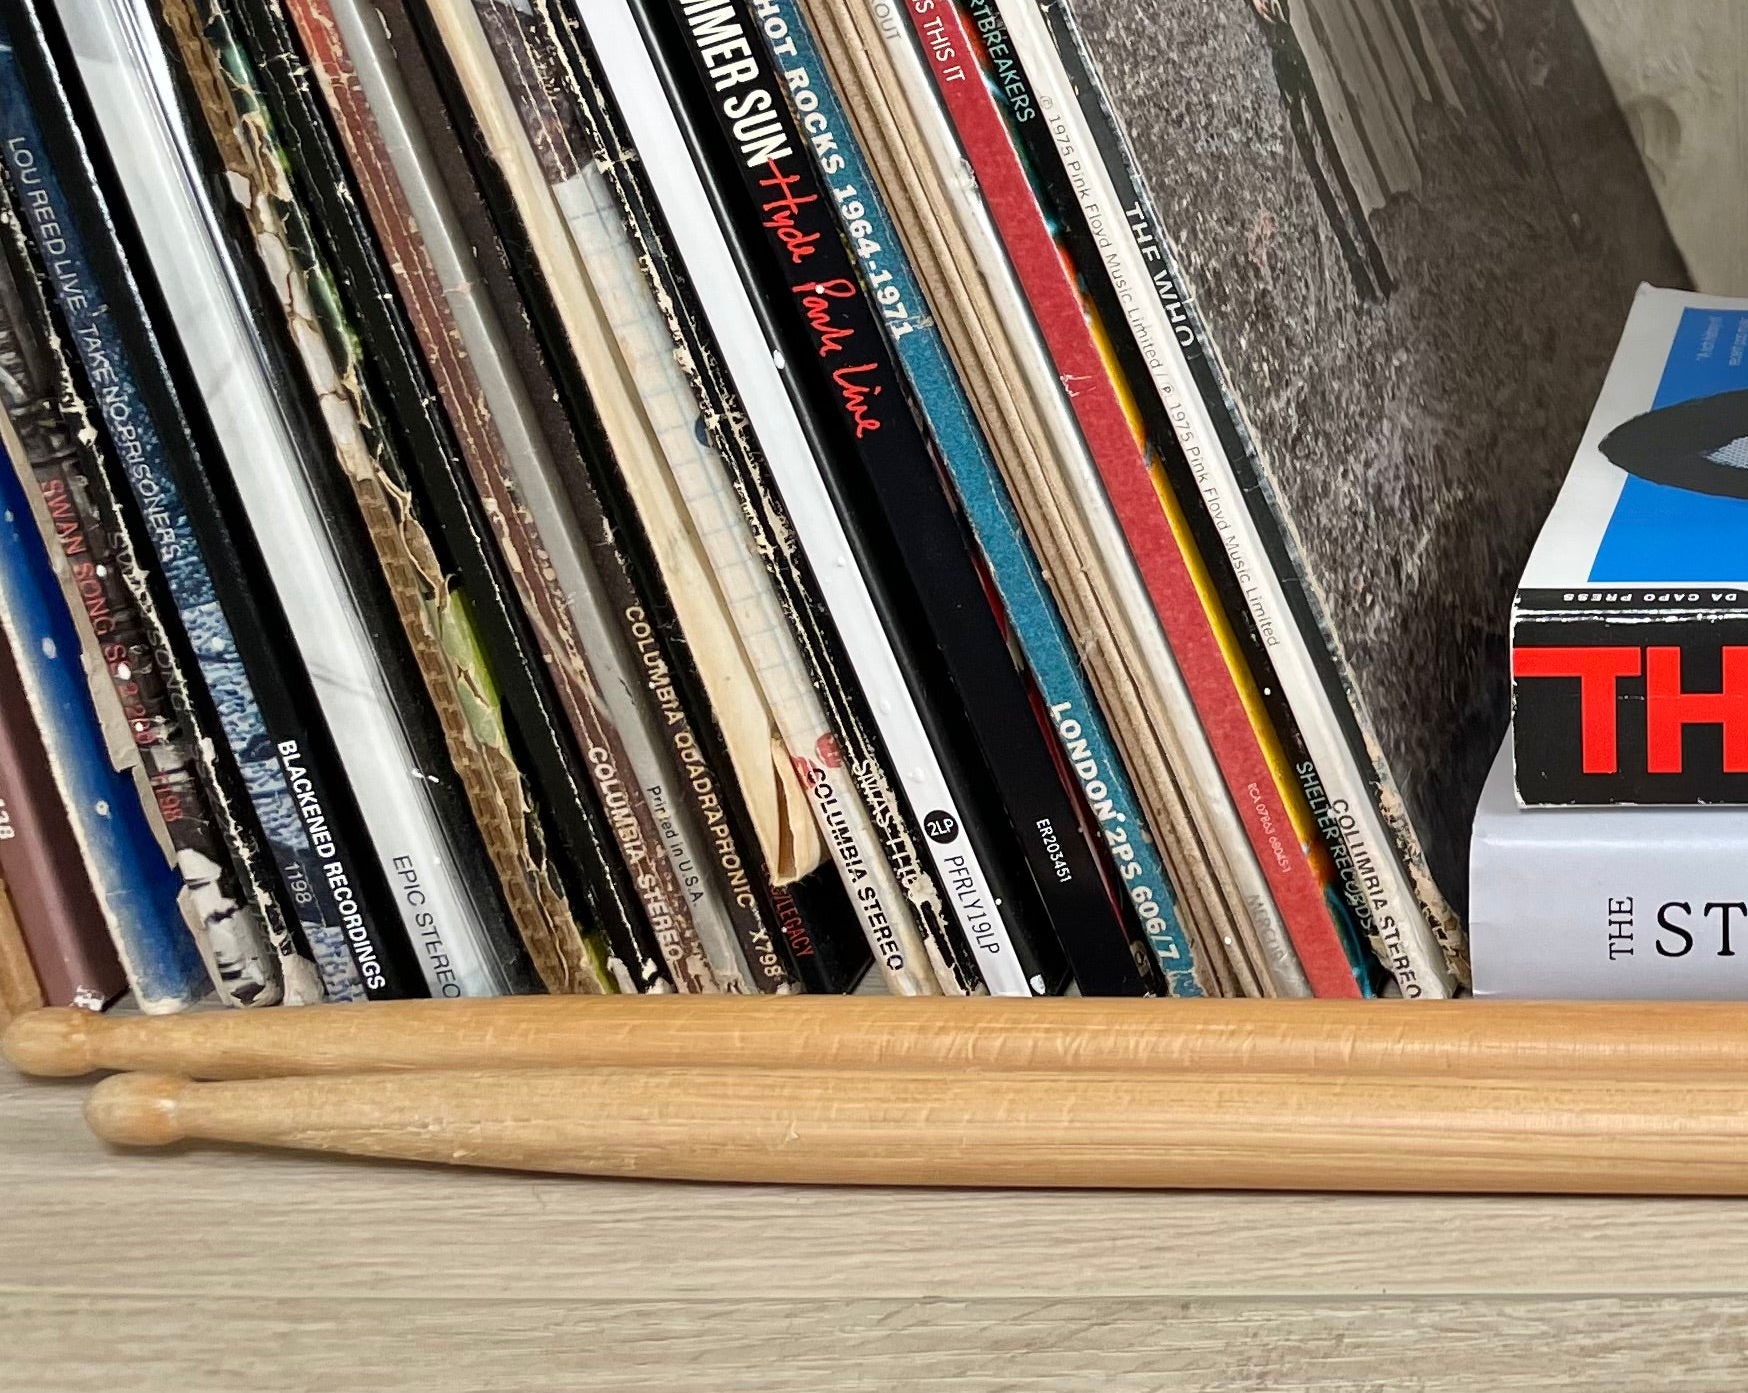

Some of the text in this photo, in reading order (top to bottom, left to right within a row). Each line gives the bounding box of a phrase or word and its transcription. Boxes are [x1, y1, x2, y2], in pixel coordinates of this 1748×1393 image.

[921, 16, 956, 62] THIS
[942, 64, 965, 86] IT
[723, 88, 794, 168] SUN
[755, 157, 818, 259] Hyde
[784, 67, 845, 174] ROCKS
[836, 185, 914, 340] 1964-1971
[1125, 203, 1195, 347] THE WHO
[6, 135, 182, 560] LOU REED LIVE TAKE NO PRISONERS
[1046, 114, 1283, 648] 1975 Pink Floyd Music Limited 1975 Pink Floyd Music Limited
[42, 480, 84, 556] SWAN
[74, 560, 114, 635] SONG
[1563, 593, 1737, 602] DA CAPO PRESS
[277, 739, 386, 989] BLACKENED RECORDINGS
[589, 747, 683, 961] COLUMBIA STEREO
[625, 607, 783, 977] COLUMBIA QUADRAPHONIC X798
[927, 818, 954, 836] 2LP
[1036, 818, 1072, 882] ER203451
[1051, 703, 1180, 963] LONDON 2PS 606/7
[1247, 782, 1265, 802] RCA
[1296, 761, 1373, 929] SHELTER RECORDS
[284, 862, 312, 903] 1198
[394, 855, 461, 999] EPIC STEREO
[672, 843, 706, 906] in U.S.A.
[811, 769, 904, 971] COLUMBIA STEREO
[944, 855, 1000, 954] PFRLY19LP
[1327, 798, 1422, 999] COLUMBIA STEREO
[1608, 896, 1634, 961] THE
